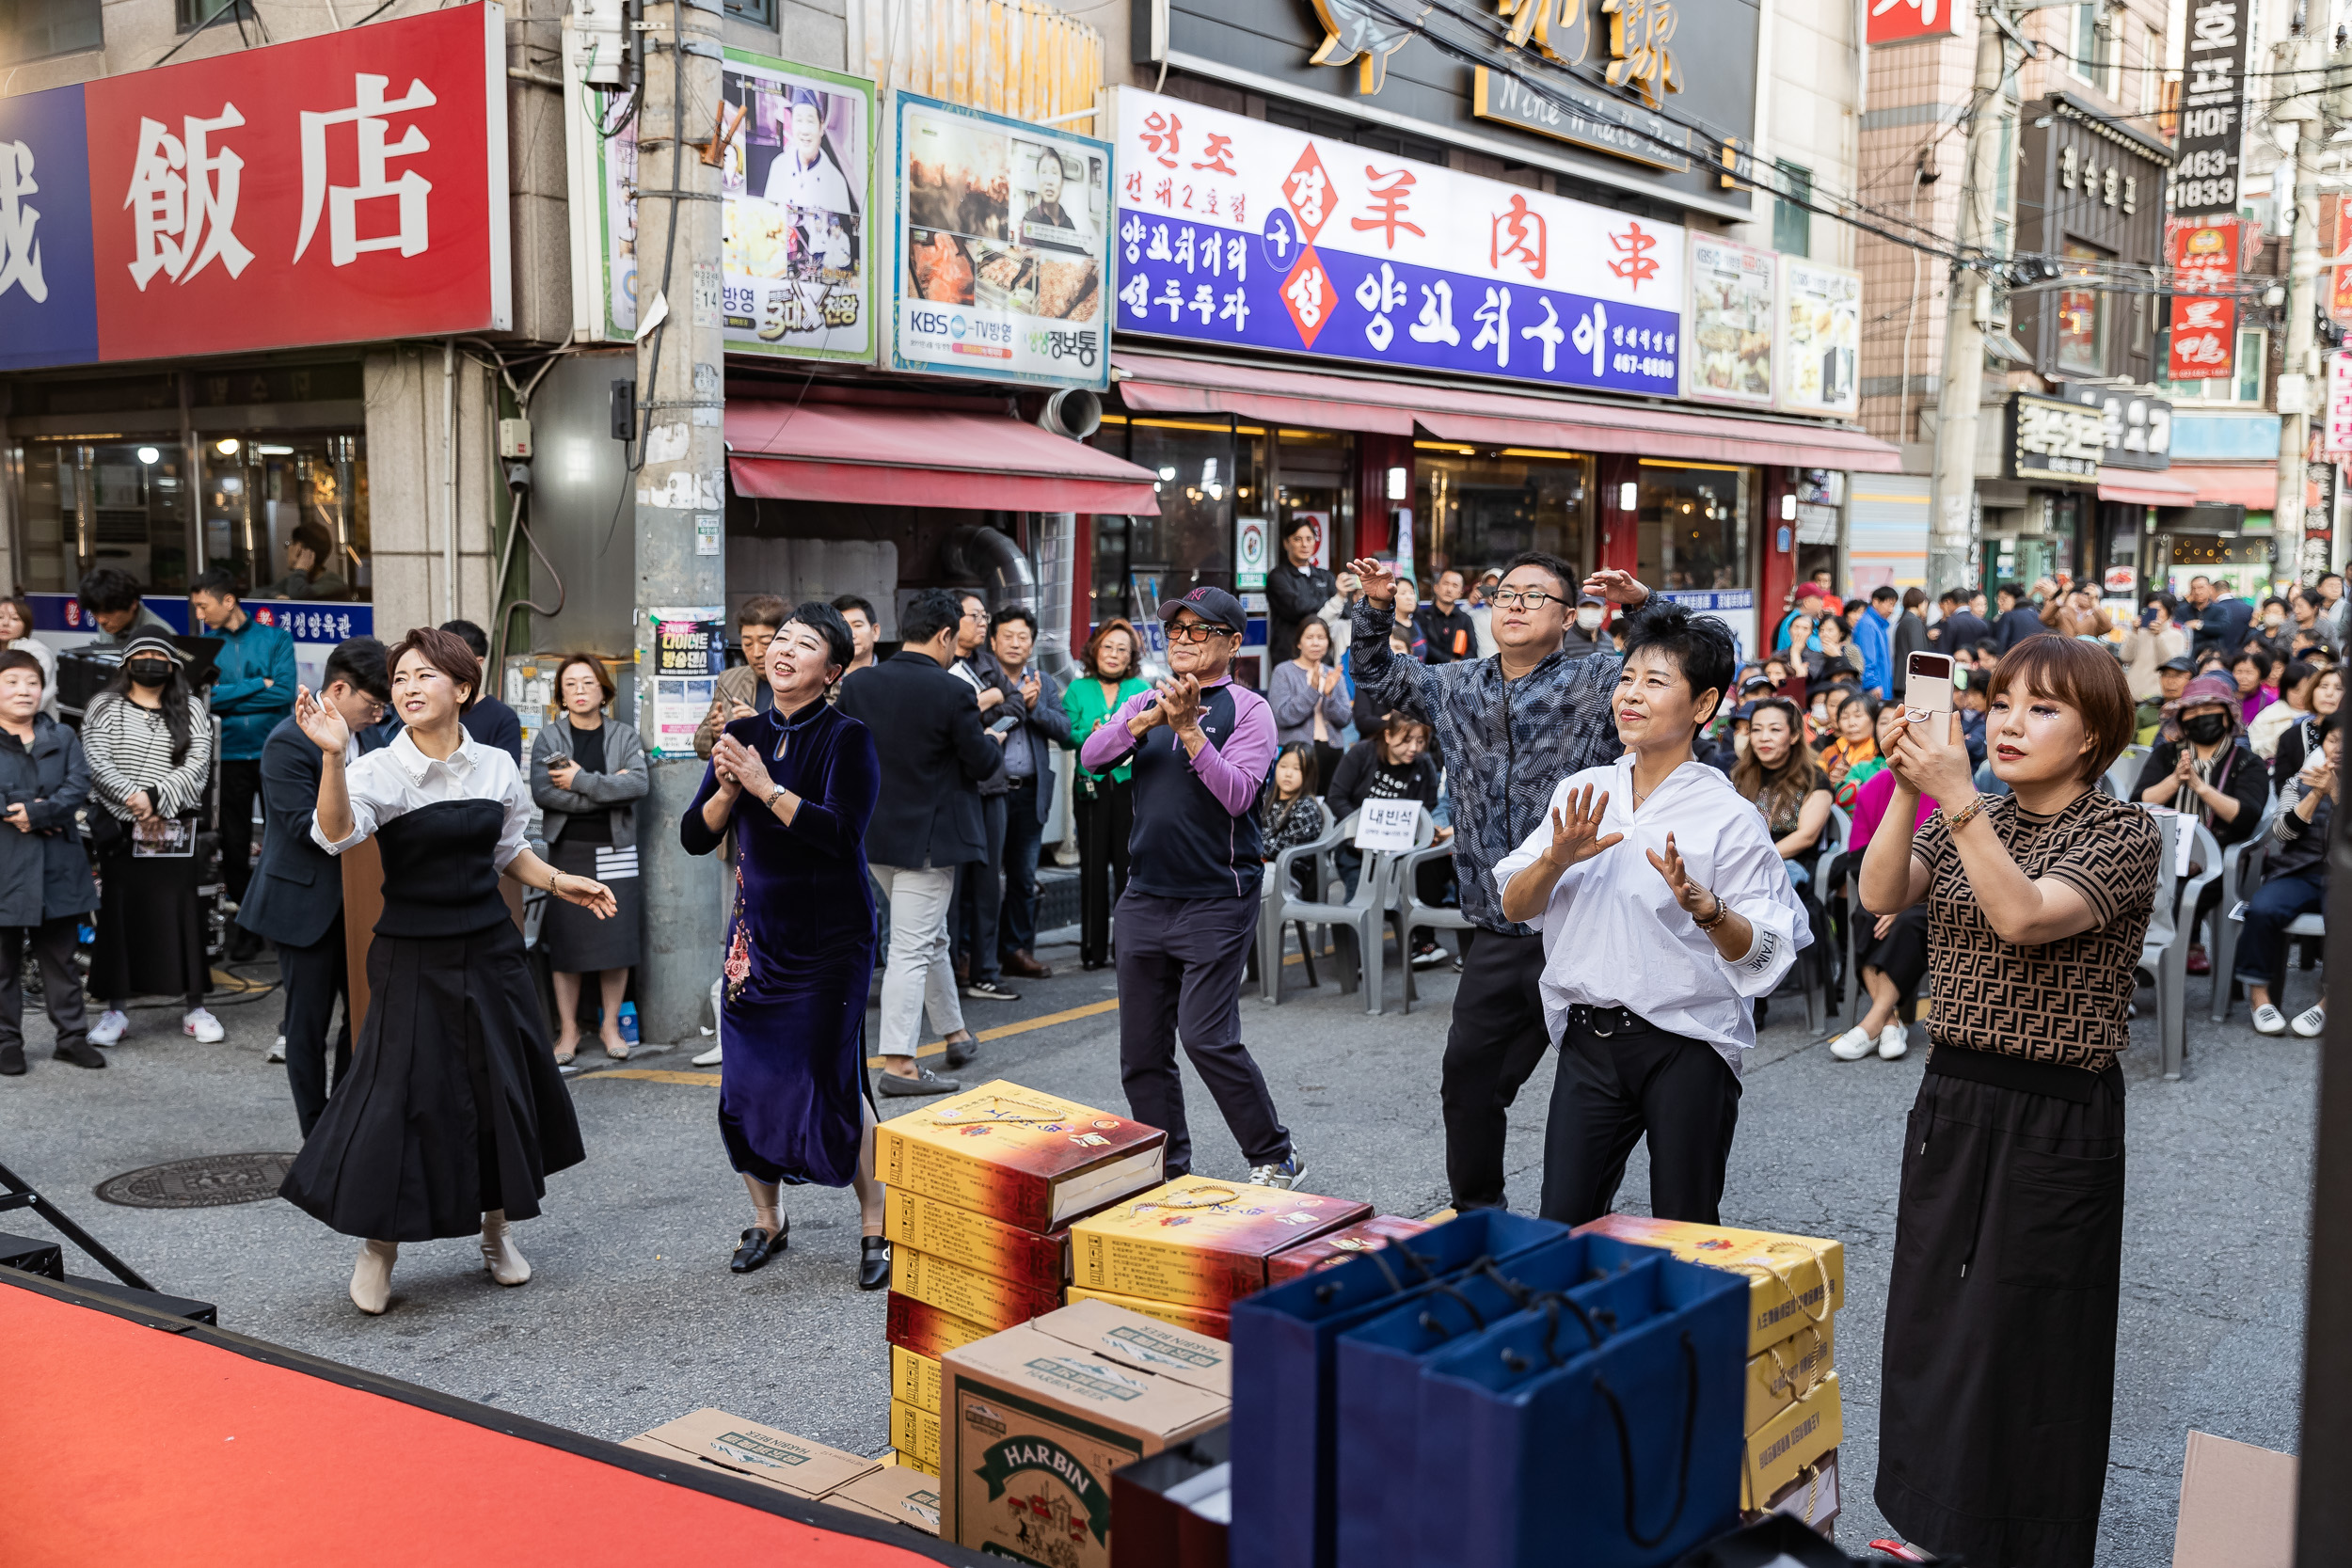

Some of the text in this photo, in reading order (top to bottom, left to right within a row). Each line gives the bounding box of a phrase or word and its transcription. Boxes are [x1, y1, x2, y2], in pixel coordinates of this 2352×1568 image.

[2183, 107, 2236, 138] HOF
[1139, 110, 1237, 177] 원조
[2176, 178, 2237, 208] 1833
[1351, 165, 1661, 293] 羊肉串
[1120, 213, 1248, 283] 양꼬치거리
[704, 291, 718, 309] 14
[1119, 272, 1251, 333] 선두주자
[911, 310, 948, 335] KBS
[1355, 262, 1608, 379] 양꼬치구이
[279, 611, 352, 640] 경성양육관
[662, 632, 709, 651] 다이어트
[661, 651, 708, 669] 방송댄스
[1369, 808, 1413, 827] 내빈석
[1139, 1326, 1221, 1356] HARBIN BEER
[1025, 1370, 1109, 1402] HARBIN BEER
[746, 1429, 811, 1454] HARBIN BEER
[1002, 1443, 1090, 1496] HARBIN
